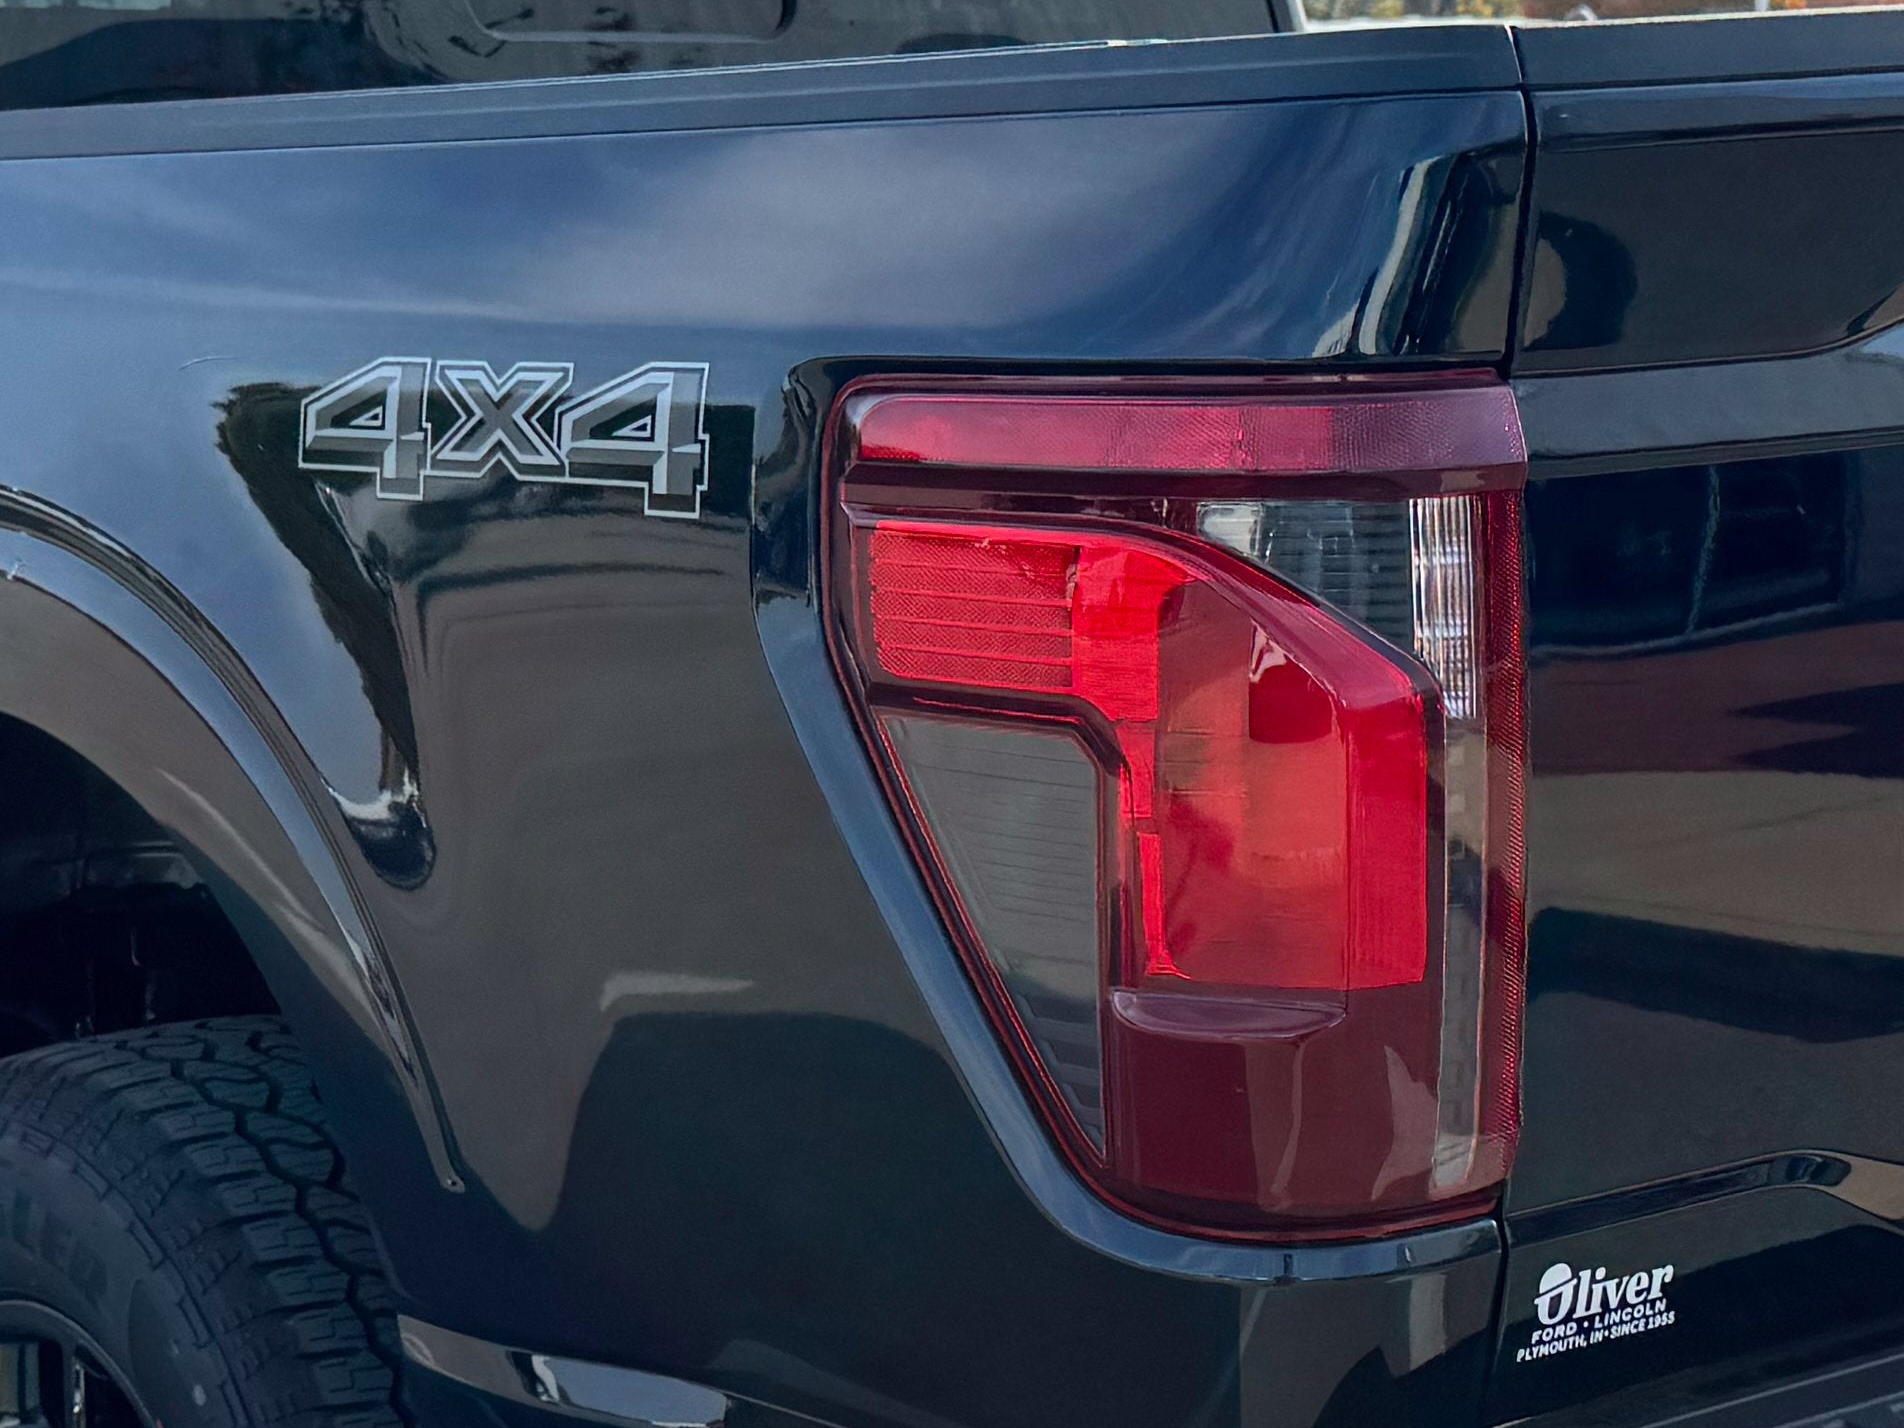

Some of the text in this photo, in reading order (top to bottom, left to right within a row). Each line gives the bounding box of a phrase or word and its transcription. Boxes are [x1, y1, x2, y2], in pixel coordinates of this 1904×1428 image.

[1534, 1263, 1674, 1325] Oliver
[1531, 1298, 1667, 1345] FORD LINCOLN
[1516, 1334, 1587, 1362] PLYMOUTH,
